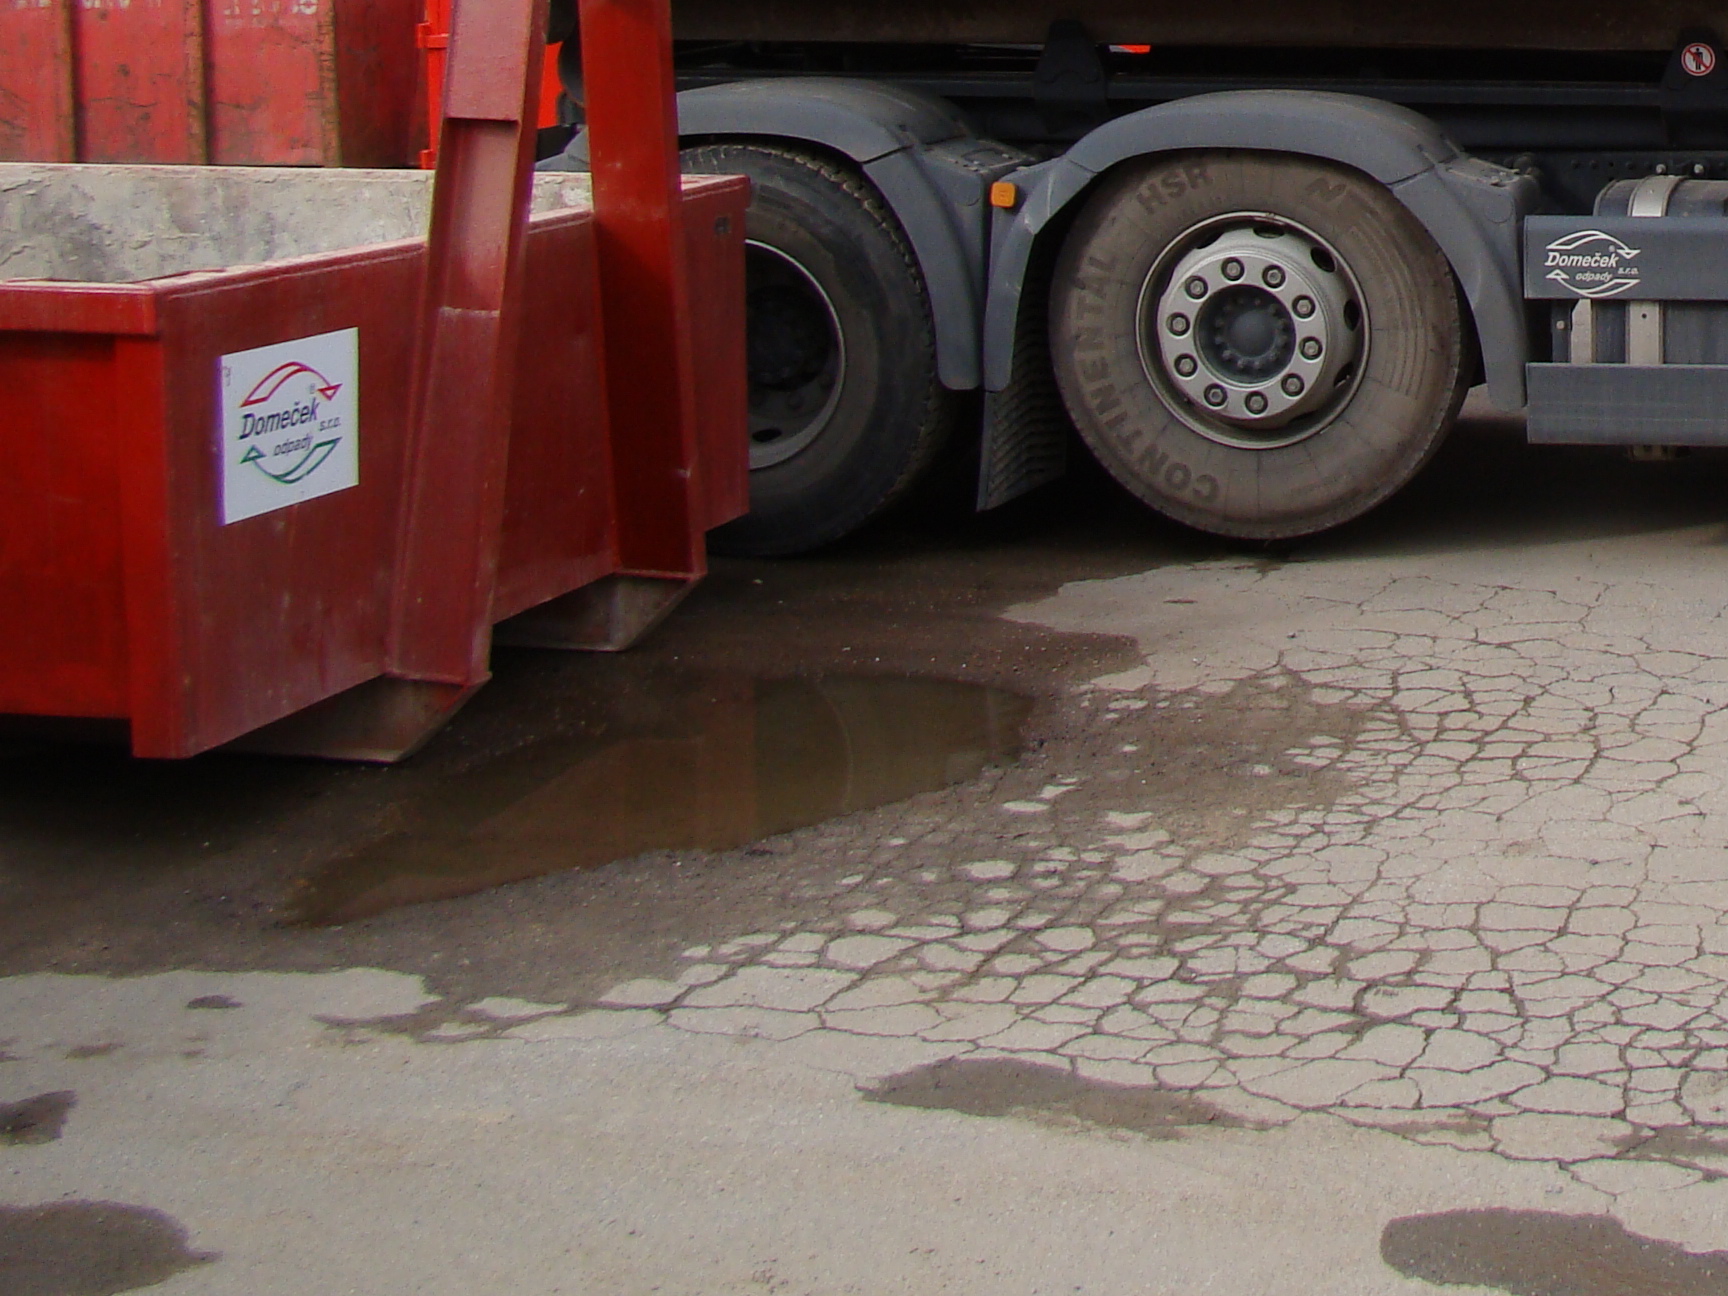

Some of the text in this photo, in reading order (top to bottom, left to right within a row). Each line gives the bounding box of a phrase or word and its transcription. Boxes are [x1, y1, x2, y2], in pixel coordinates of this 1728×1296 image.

[1544, 252, 1620, 268] Domeček
[1575, 270, 1613, 283] odpady
[238, 397, 321, 440] Domeček
[272, 433, 314, 457] odpady
